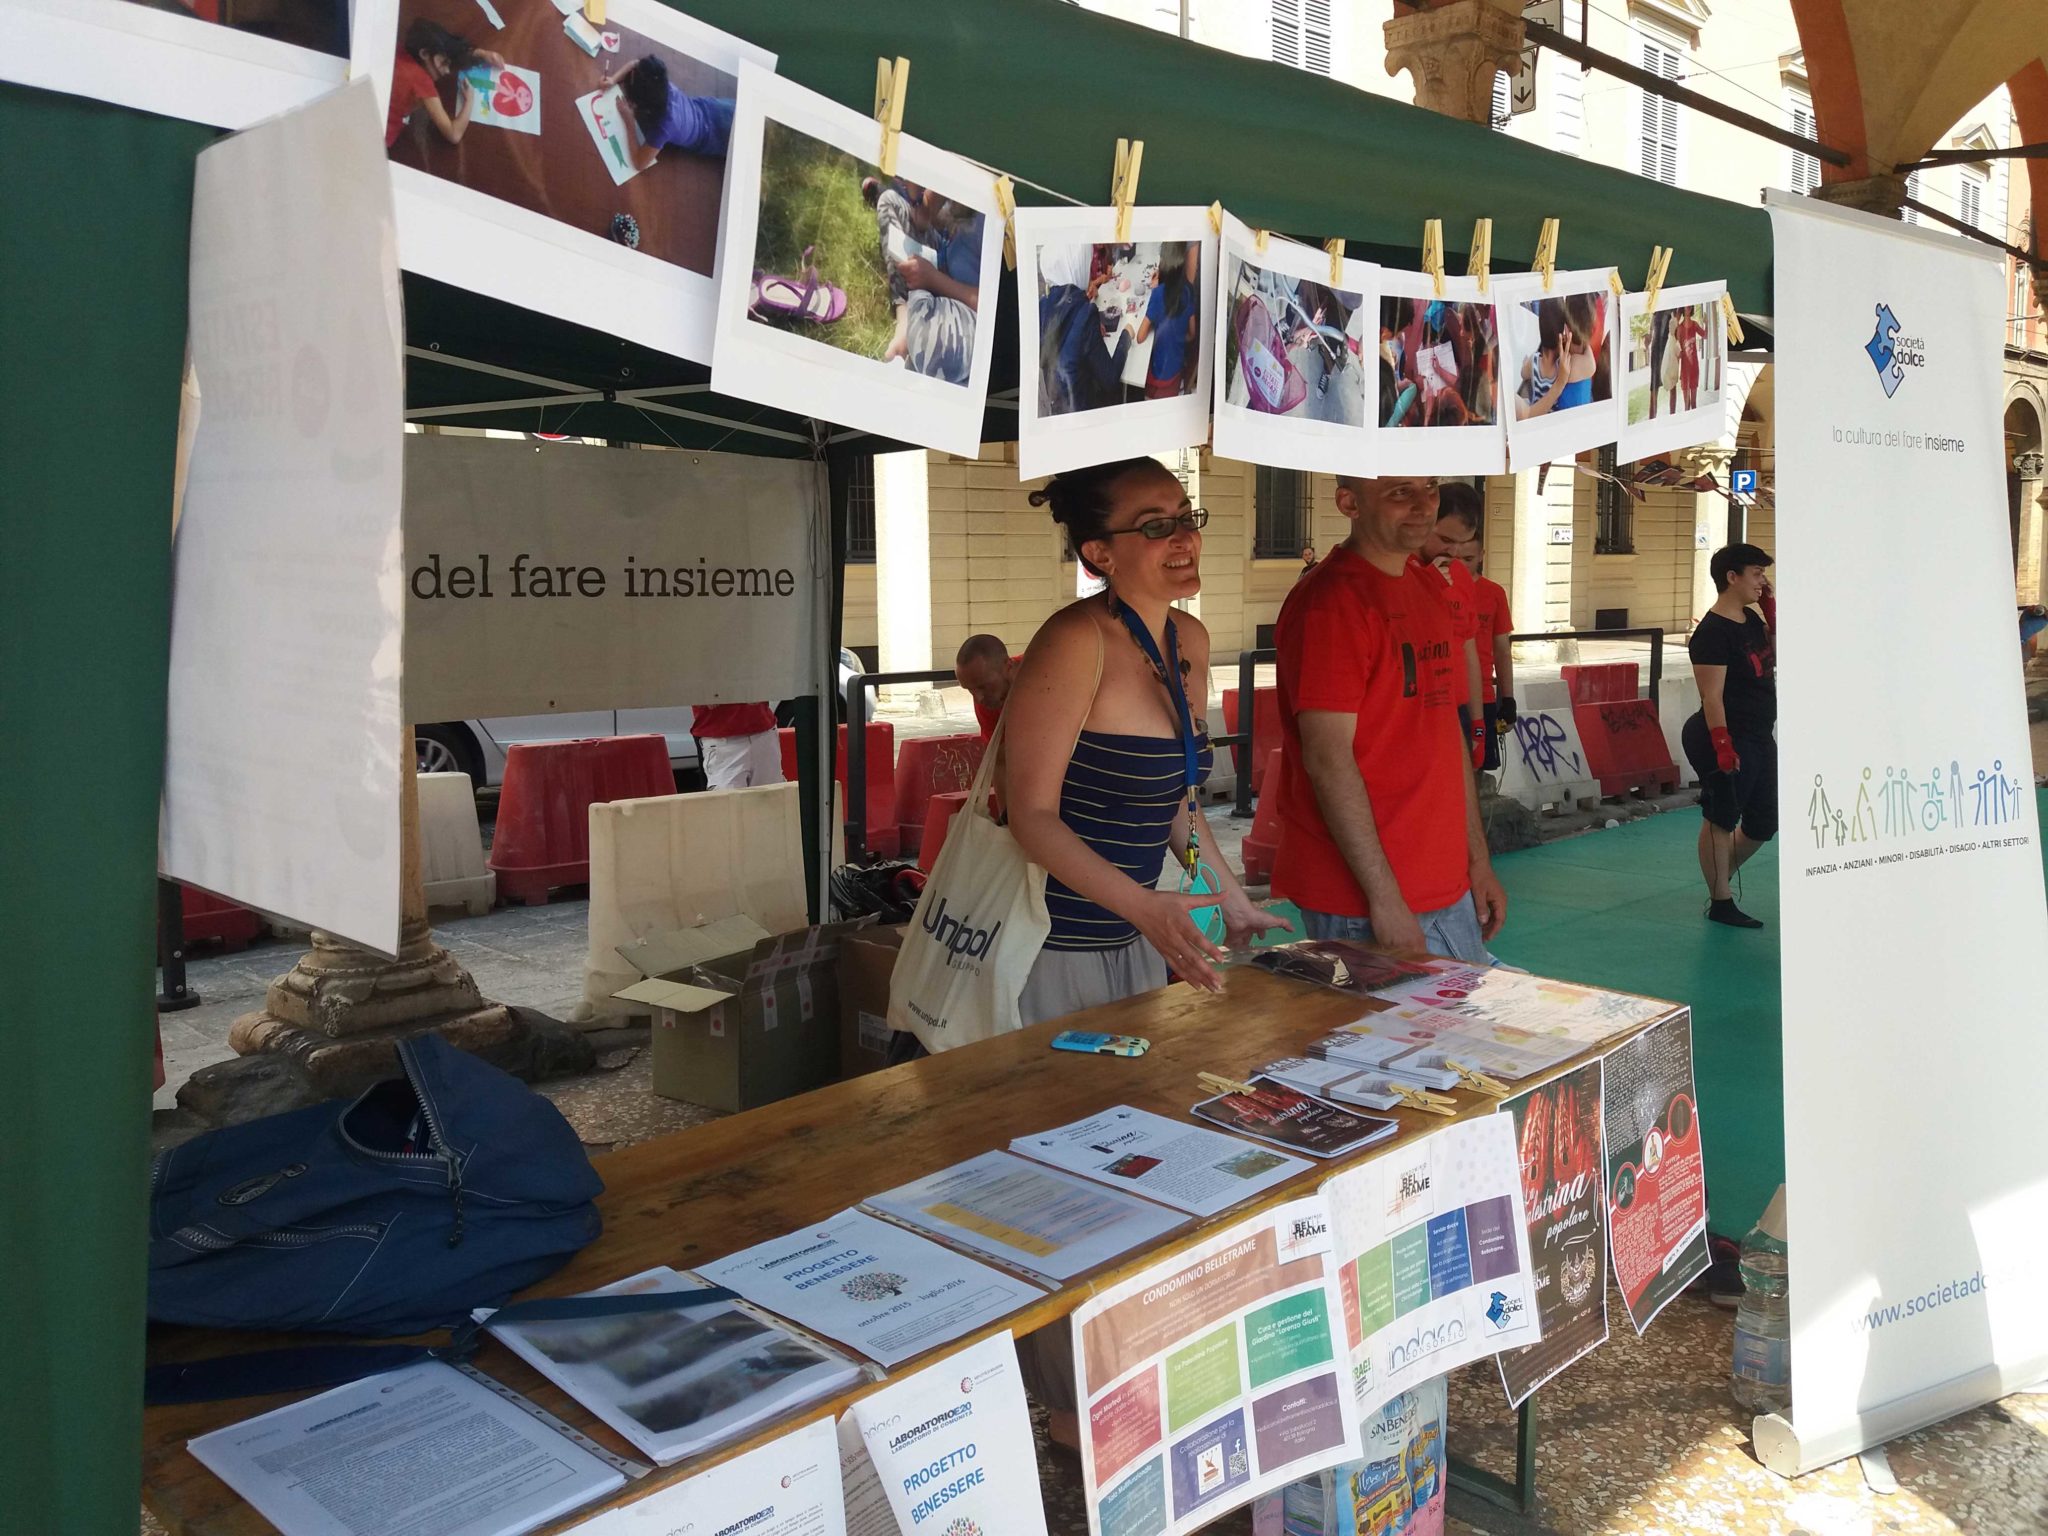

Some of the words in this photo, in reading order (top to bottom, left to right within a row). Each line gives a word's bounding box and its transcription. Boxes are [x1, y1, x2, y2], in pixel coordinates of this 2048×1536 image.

[1896, 336, 1925, 350] società
[1897, 349, 1925, 368] dolce
[1832, 425, 1843, 443] la
[1845, 427, 1882, 446] cultura
[1884, 430, 1900, 447] del
[1902, 431, 1922, 449] fare
[1924, 433, 1965, 453] insieme
[1737, 473, 1752, 491] P
[411, 554, 494, 599] del
[508, 554, 606, 598] fare
[623, 556, 795, 598] insieme
[1805, 863, 1838, 878] INFANZIA
[1843, 857, 1874, 871] ANZIANI
[1878, 853, 1905, 865] MINORI
[1909, 846, 1945, 860] DISABILITÀ
[1949, 841, 1977, 854] DISAGIO
[1982, 839, 2002, 849] ALTRI
[2003, 836, 2030, 848] SETTORI
[922, 889, 1002, 966] Unipol
[951, 960, 981, 977] GRUPPO
[907, 1000, 947, 1029] www.unipol.it
[1399, 1177, 1430, 1200] TRAME
[1526, 1169, 1590, 1227] alestrina
[1292, 1224, 1327, 1240] TRAME
[1544, 1204, 1590, 1249] popolare
[783, 1248, 859, 1282] PROGETTO
[795, 1254, 879, 1291] BENESSERE
[1142, 1265, 1204, 1306] CONDOMINIO
[1204, 1238, 1257, 1275] BELLETRAME
[857, 1310, 891, 1329] ottobre
[888, 1301, 912, 1315] 2015
[918, 1287, 945, 1302] luglio
[943, 1278, 966, 1292] 2016
[1503, 1301, 1525, 1314] dolce
[1851, 1271, 1990, 1335] www.societado
[1251, 1330, 1276, 1346] Giardino
[1257, 1324, 1272, 1335] Cura
[1277, 1313, 1302, 1329] gestione
[1302, 1308, 1313, 1318] del
[888, 1400, 973, 1450] LABORATORIOE20
[891, 1428, 933, 1455] LABORATORIO
[932, 1424, 940, 1433] DI
[939, 1409, 974, 1430] COMUNITÀ
[1179, 1427, 1220, 1455] Collaborazione
[902, 1442, 978, 1496] PROGETTO
[910, 1466, 986, 1526] BENESSERE
[712, 1505, 775, 1536] ABORATORIOE20
